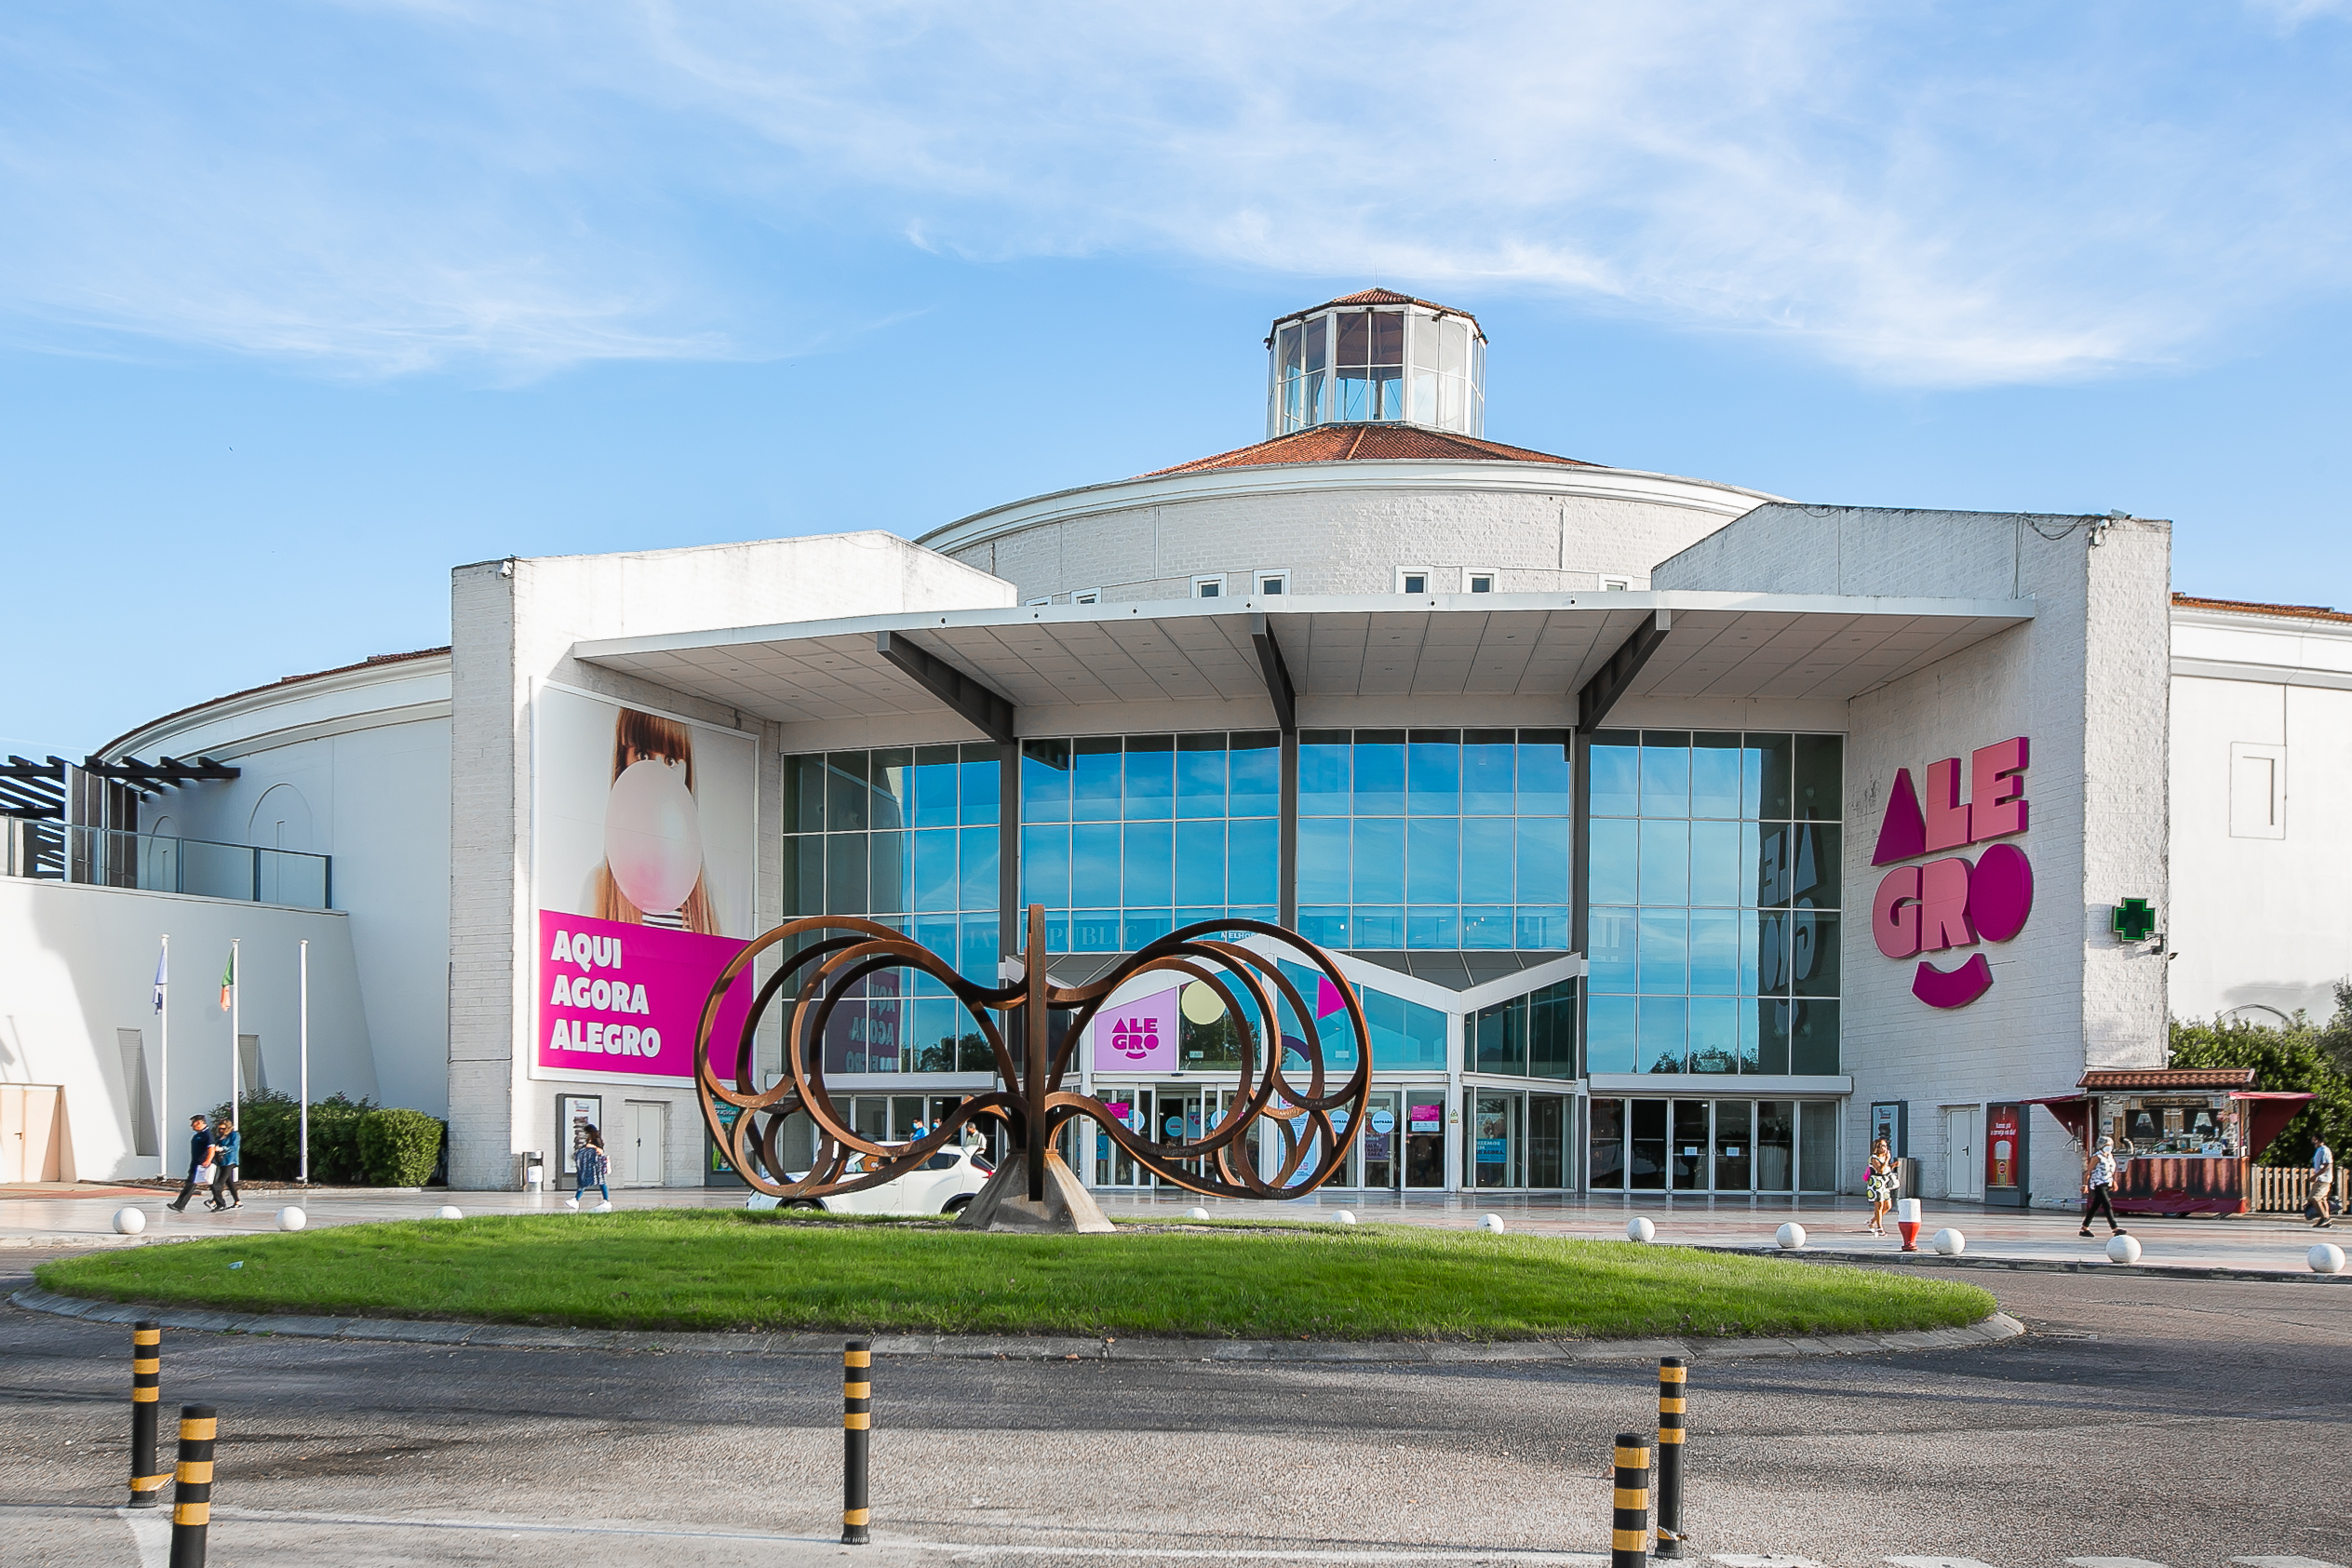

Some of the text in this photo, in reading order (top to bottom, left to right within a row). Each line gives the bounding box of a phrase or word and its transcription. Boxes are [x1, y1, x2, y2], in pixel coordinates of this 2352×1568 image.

[1871, 736, 2029, 866] ALE
[1872, 843, 2033, 958] GRO
[550, 930, 623, 973] AQUI
[550, 974, 650, 1015] AGORA
[549, 1018, 662, 1058] ALEGRO
[1111, 1017, 1158, 1033] ALE
[1111, 1034, 1160, 1051] GRO
